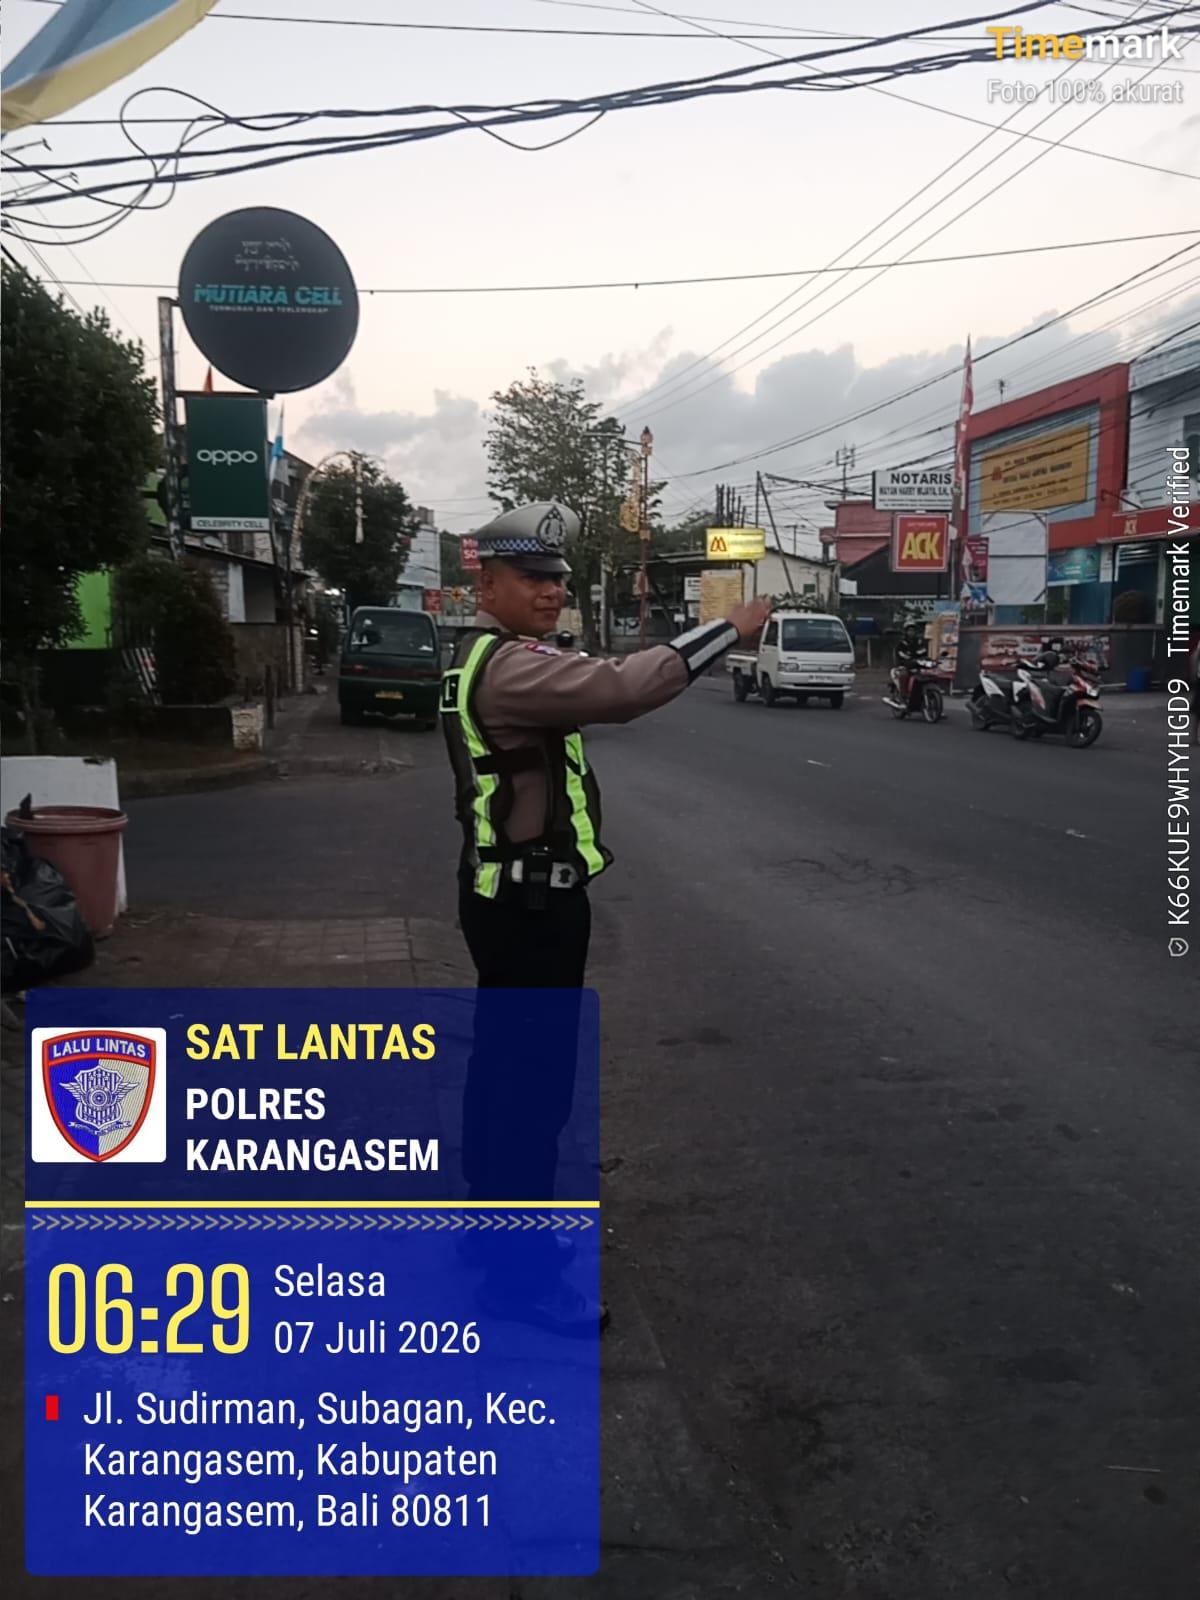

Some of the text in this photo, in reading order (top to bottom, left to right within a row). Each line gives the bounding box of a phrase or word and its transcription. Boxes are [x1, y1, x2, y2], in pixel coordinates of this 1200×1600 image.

[194, 284, 343, 305] MUTIARA CELL
[196, 449, 258, 466] oppo
[890, 473, 952, 485] NOTARIS
[243, 520, 265, 529] CELL
[901, 532, 941, 560] ACK
